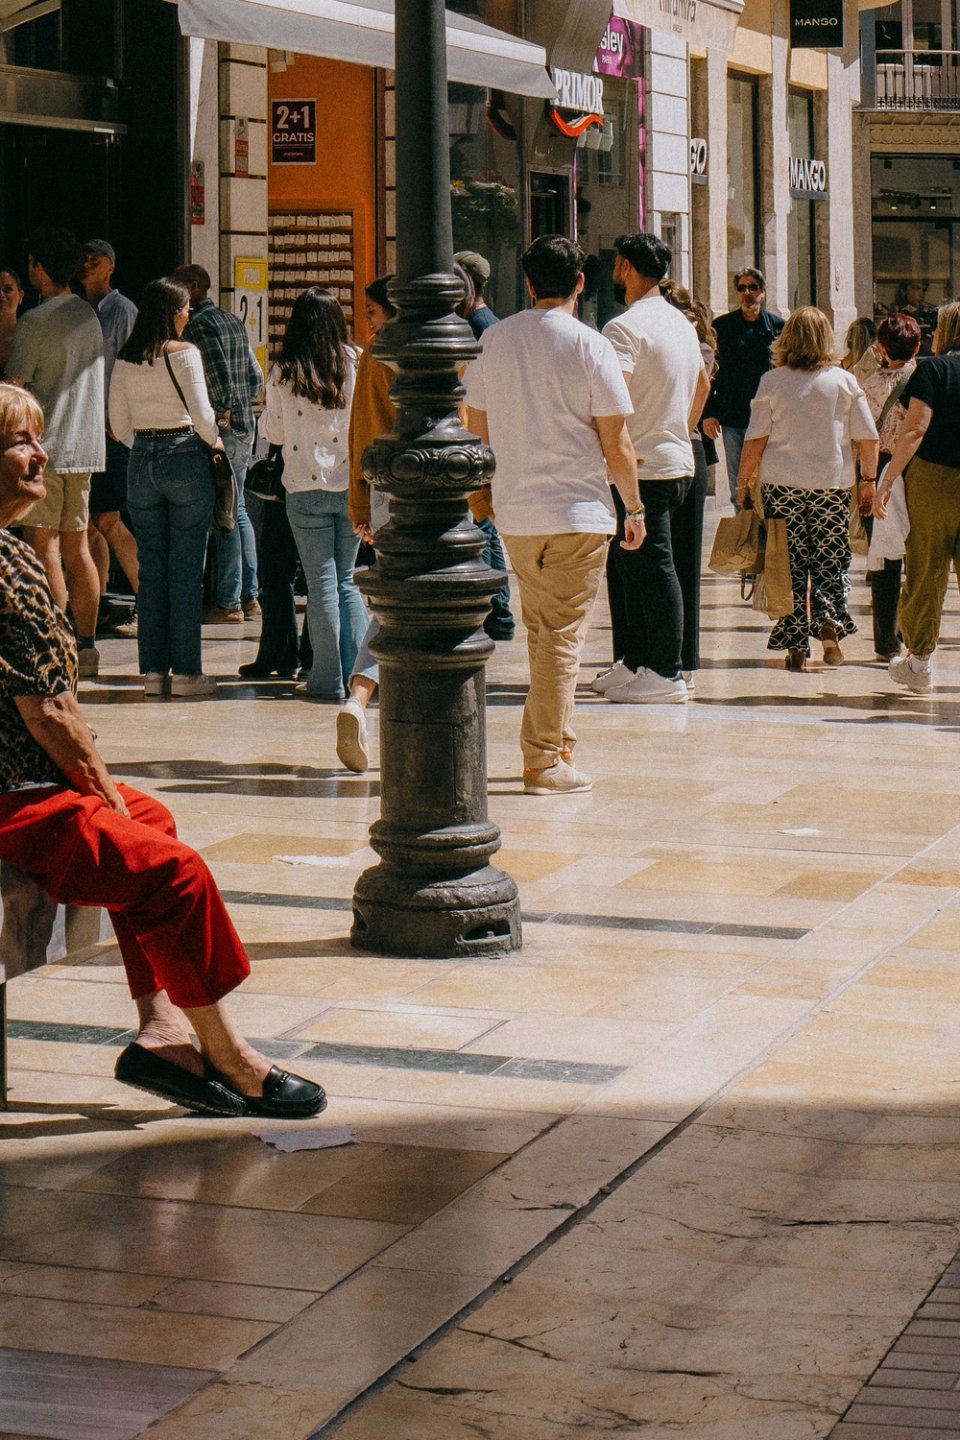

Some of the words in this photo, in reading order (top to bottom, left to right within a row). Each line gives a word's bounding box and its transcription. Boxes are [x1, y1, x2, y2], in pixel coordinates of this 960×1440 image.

[794, 17, 839, 27] MANGO
[552, 67, 605, 115] PRIMOR
[276, 105, 310, 129] 2+1
[272, 132, 315, 143] GRATIS
[788, 156, 826, 192] MANGO
